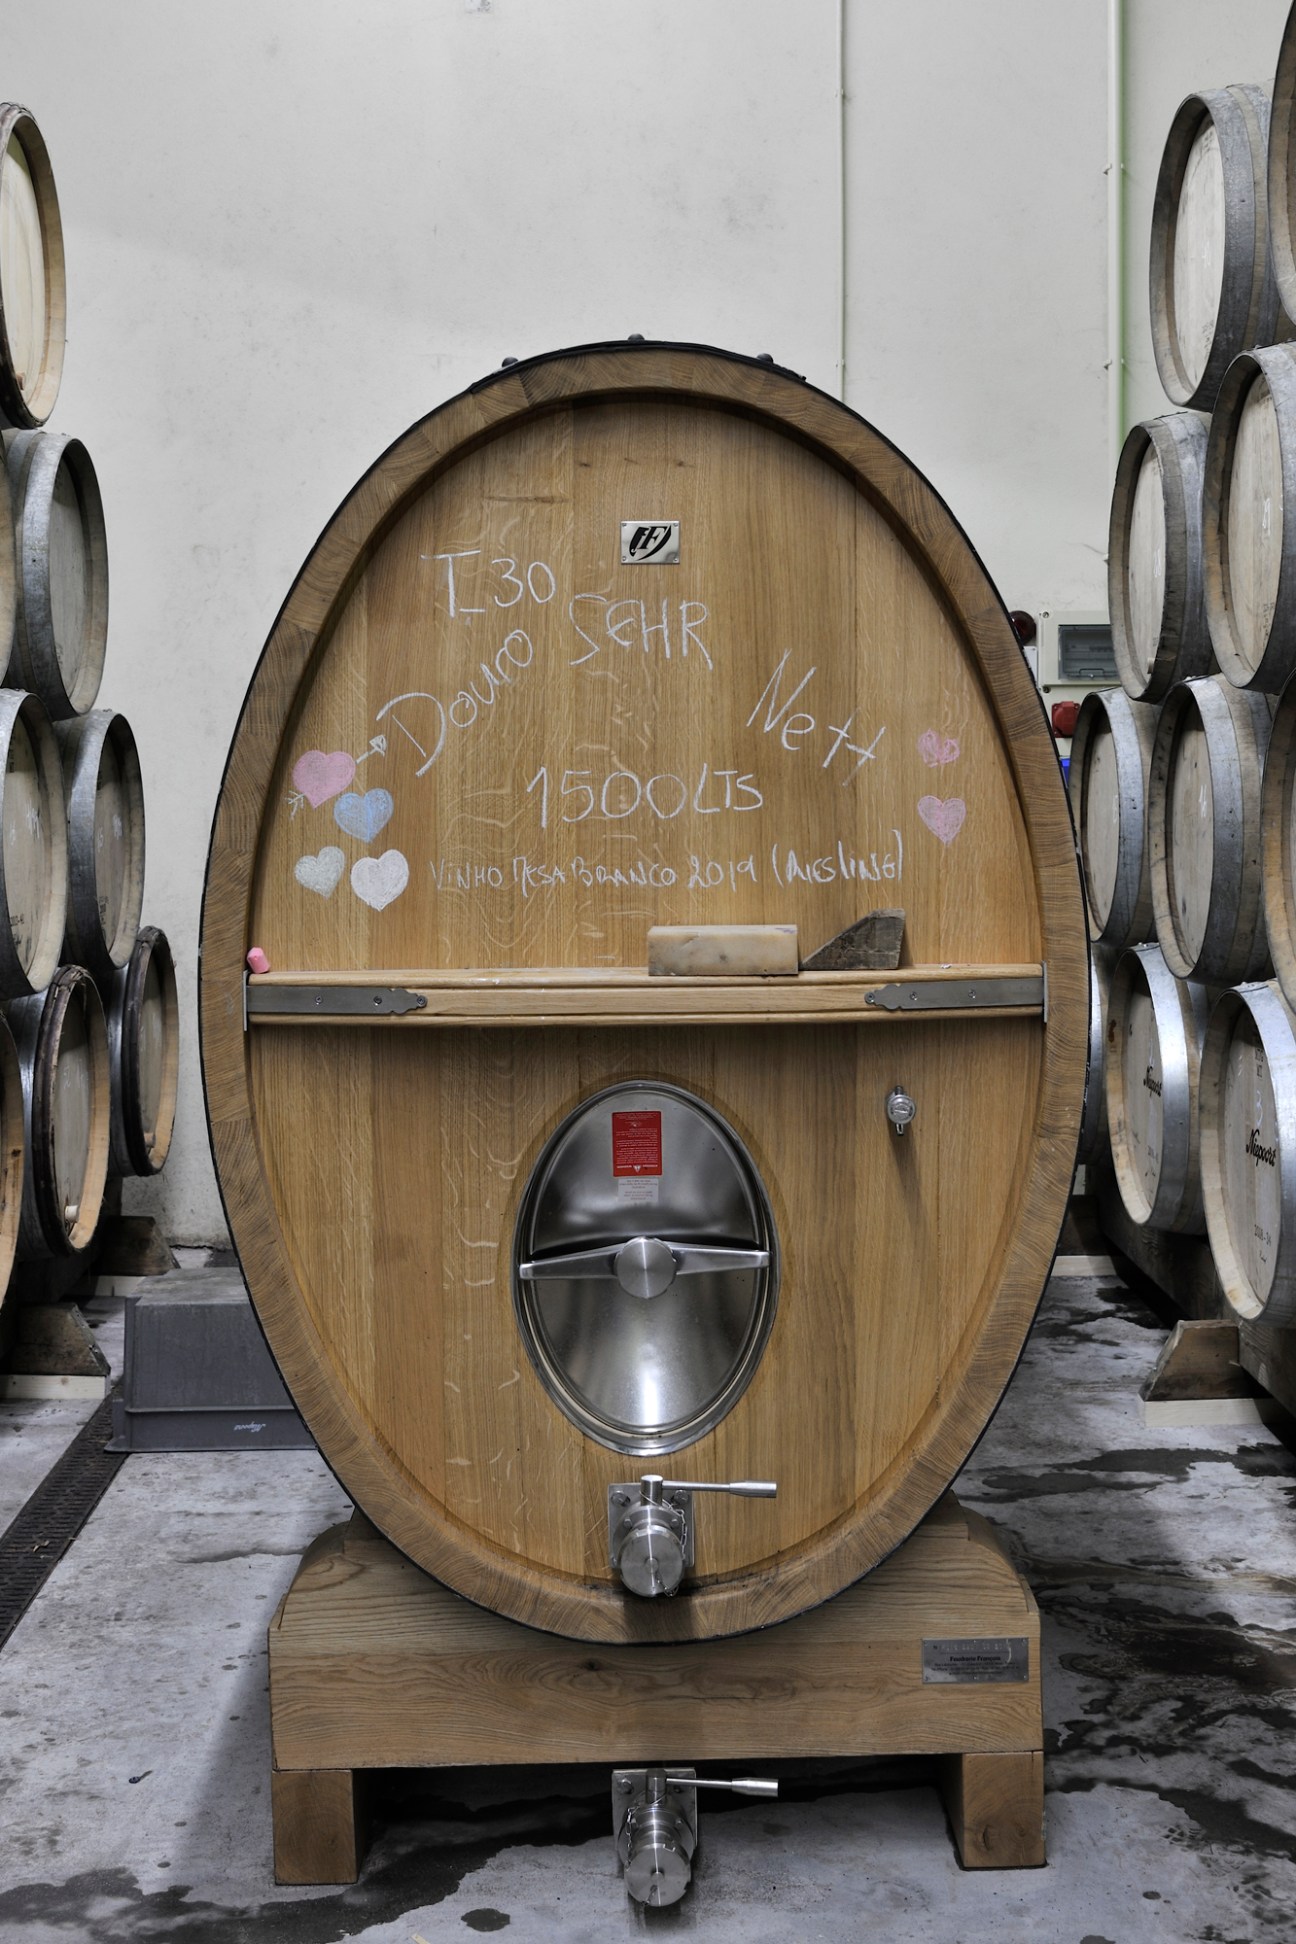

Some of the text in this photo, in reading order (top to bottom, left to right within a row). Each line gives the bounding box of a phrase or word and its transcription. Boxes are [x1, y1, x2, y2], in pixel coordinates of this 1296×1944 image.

[376, 629, 533, 777] Douro
[687, 855, 758, 893] 2019
[1245, 1128, 1277, 1167] Niepoort
